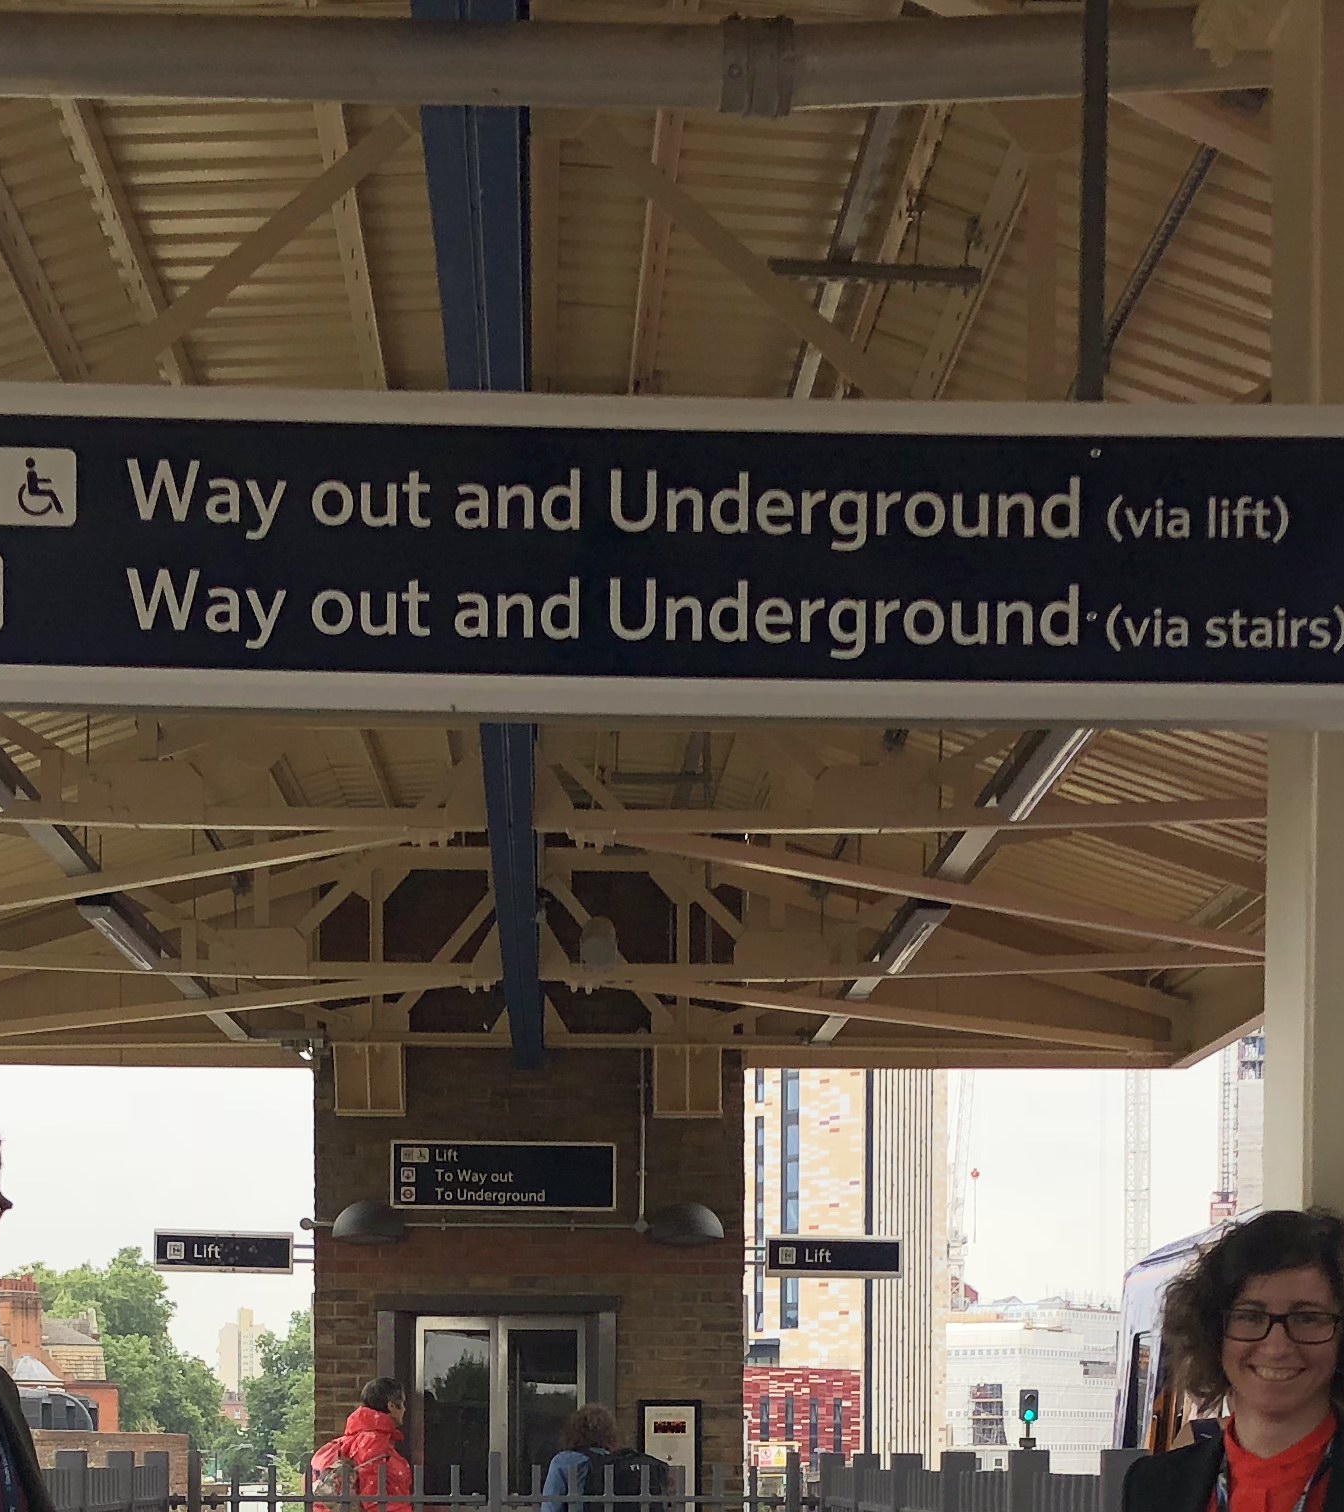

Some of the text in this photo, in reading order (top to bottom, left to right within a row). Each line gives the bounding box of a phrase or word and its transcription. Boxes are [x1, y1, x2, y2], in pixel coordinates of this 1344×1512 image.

[126, 459, 1289, 550] Way out and Underground (via lift)
[126, 568, 287, 649] Way
[311, 579, 431, 636] out
[455, 578, 581, 639] and
[609, 578, 1079, 659] Underground
[1106, 605, 1189, 651] (via
[435, 1148, 459, 1162] Lift
[435, 1168, 514, 1185] To Way out
[435, 1187, 546, 1204] To Underground
[193, 1243, 221, 1259] Lift
[805, 1248, 832, 1263] Lift
